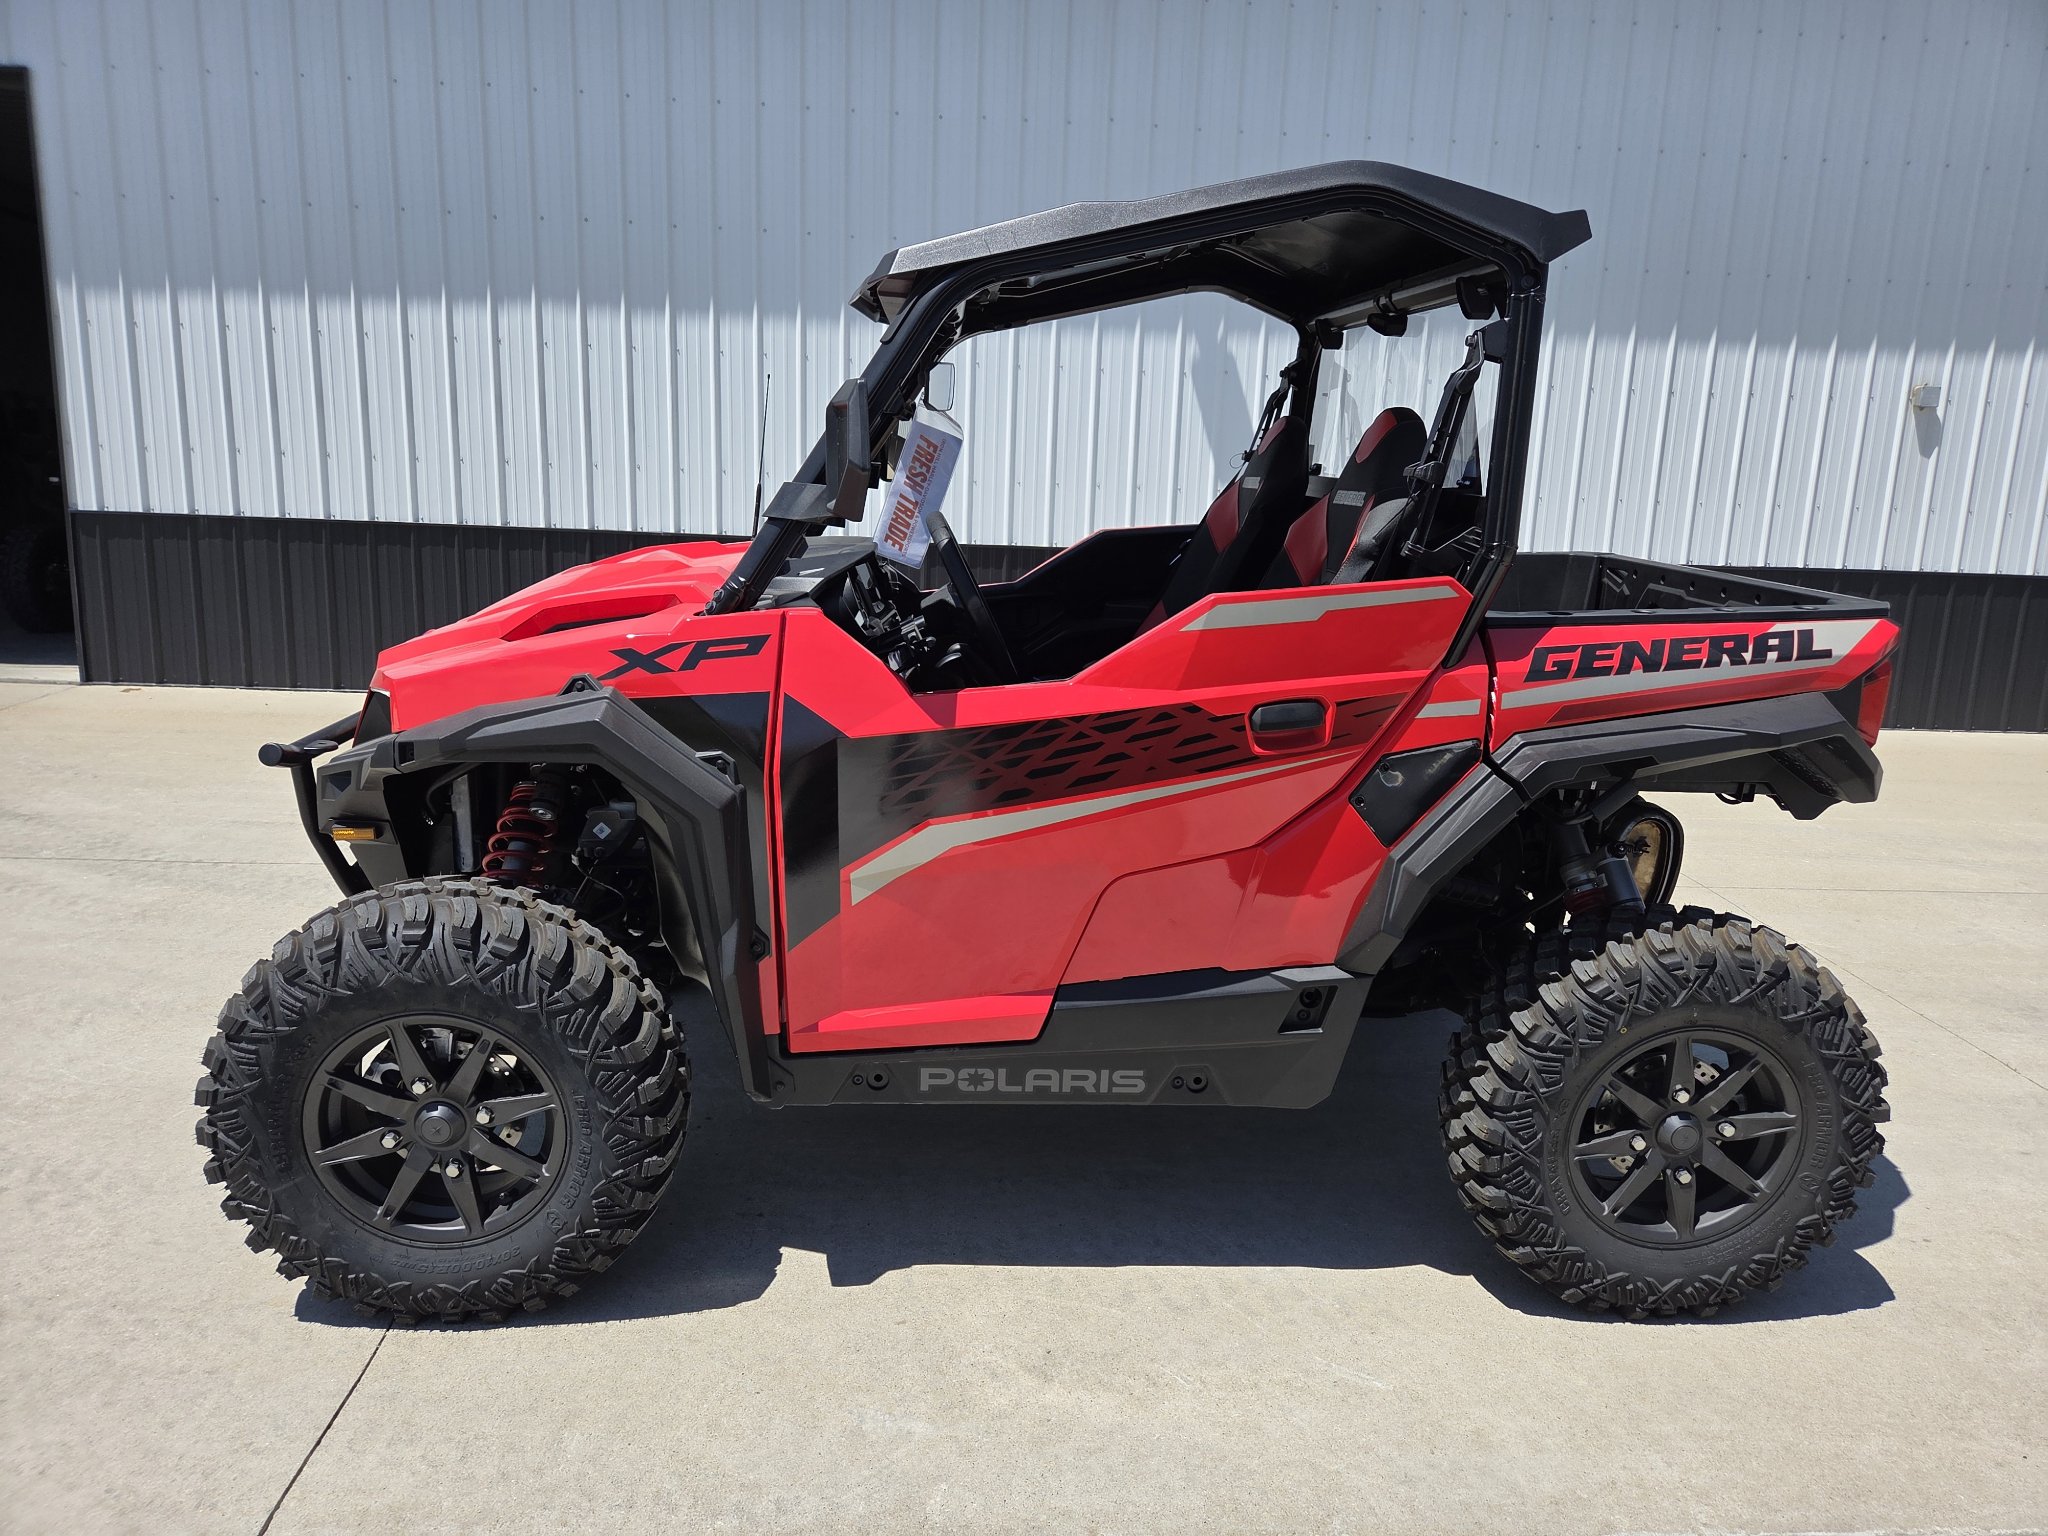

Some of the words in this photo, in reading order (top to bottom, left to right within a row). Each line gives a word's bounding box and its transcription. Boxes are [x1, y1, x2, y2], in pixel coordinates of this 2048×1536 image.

[902, 433, 939, 495] FRESH
[882, 492, 919, 552] TRADE
[596, 634, 772, 681] XP
[1524, 628, 1832, 683] GENERAL
[919, 1067, 1146, 1093] POLARIS
